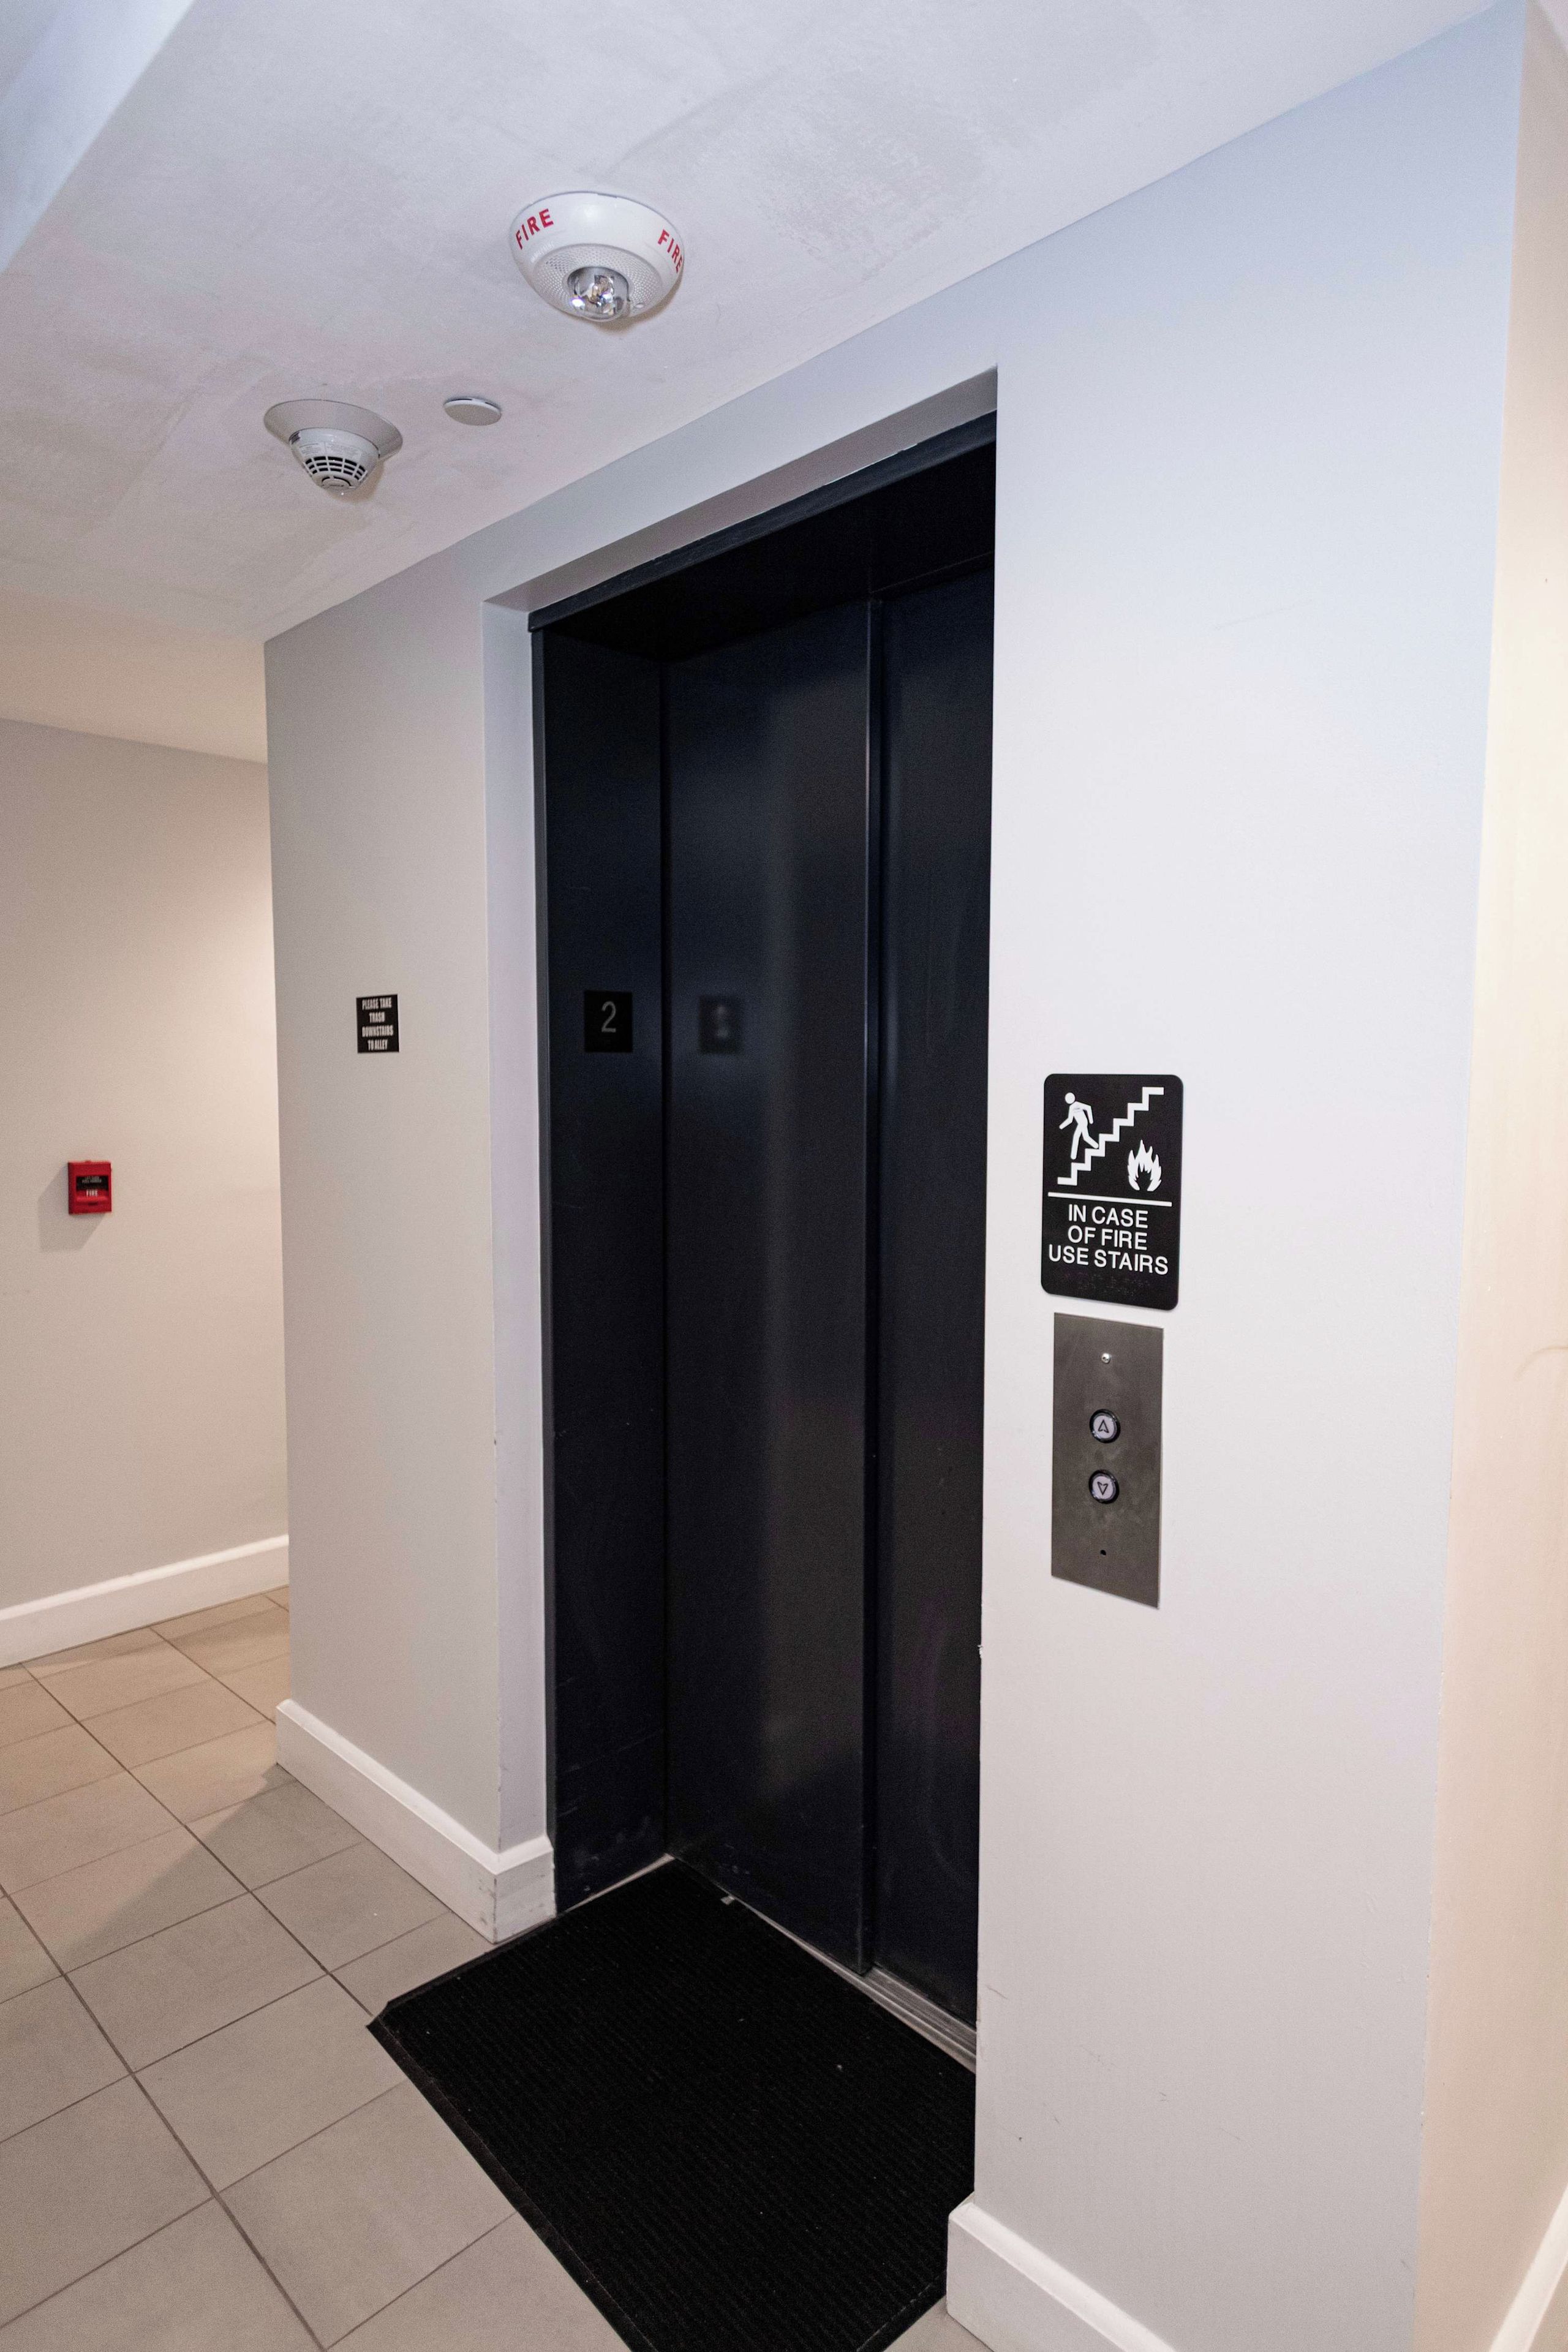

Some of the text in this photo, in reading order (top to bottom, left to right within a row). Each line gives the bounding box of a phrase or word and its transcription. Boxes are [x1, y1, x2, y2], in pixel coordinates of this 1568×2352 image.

[515, 209, 554, 250] FIRE
[657, 229, 683, 274] FIRE
[362, 997, 392, 1011] PLEASE TAKE
[369, 1012, 385, 1023] TRASH
[601, 1001, 617, 1033] 2
[362, 1025, 394, 1038] DOWNSTAIRS
[374, 1039, 388, 1050] ALLEY
[1068, 1204, 1148, 1229] IN CASE
[1068, 1225, 1148, 1251] OF FIRE
[1048, 1244, 1169, 1276] USE STAIRS
